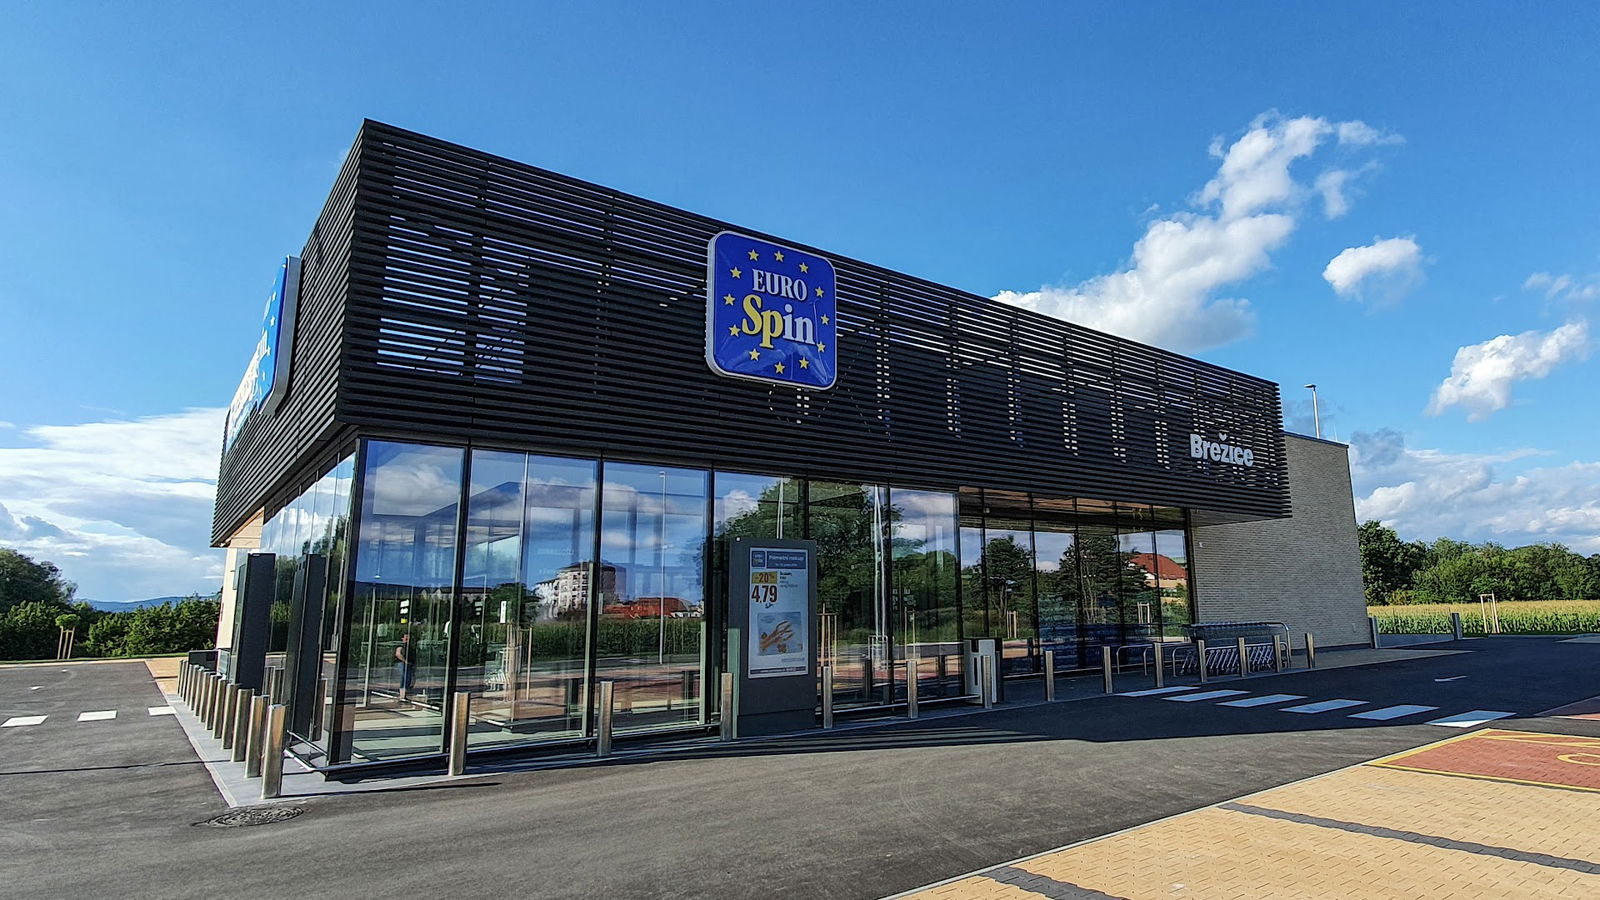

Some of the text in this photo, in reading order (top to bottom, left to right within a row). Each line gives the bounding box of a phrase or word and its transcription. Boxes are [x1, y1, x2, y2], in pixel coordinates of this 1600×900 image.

[752, 269, 807, 301] EURO
[742, 295, 815, 348] Spin
[1190, 433, 1253, 467] Brežice
